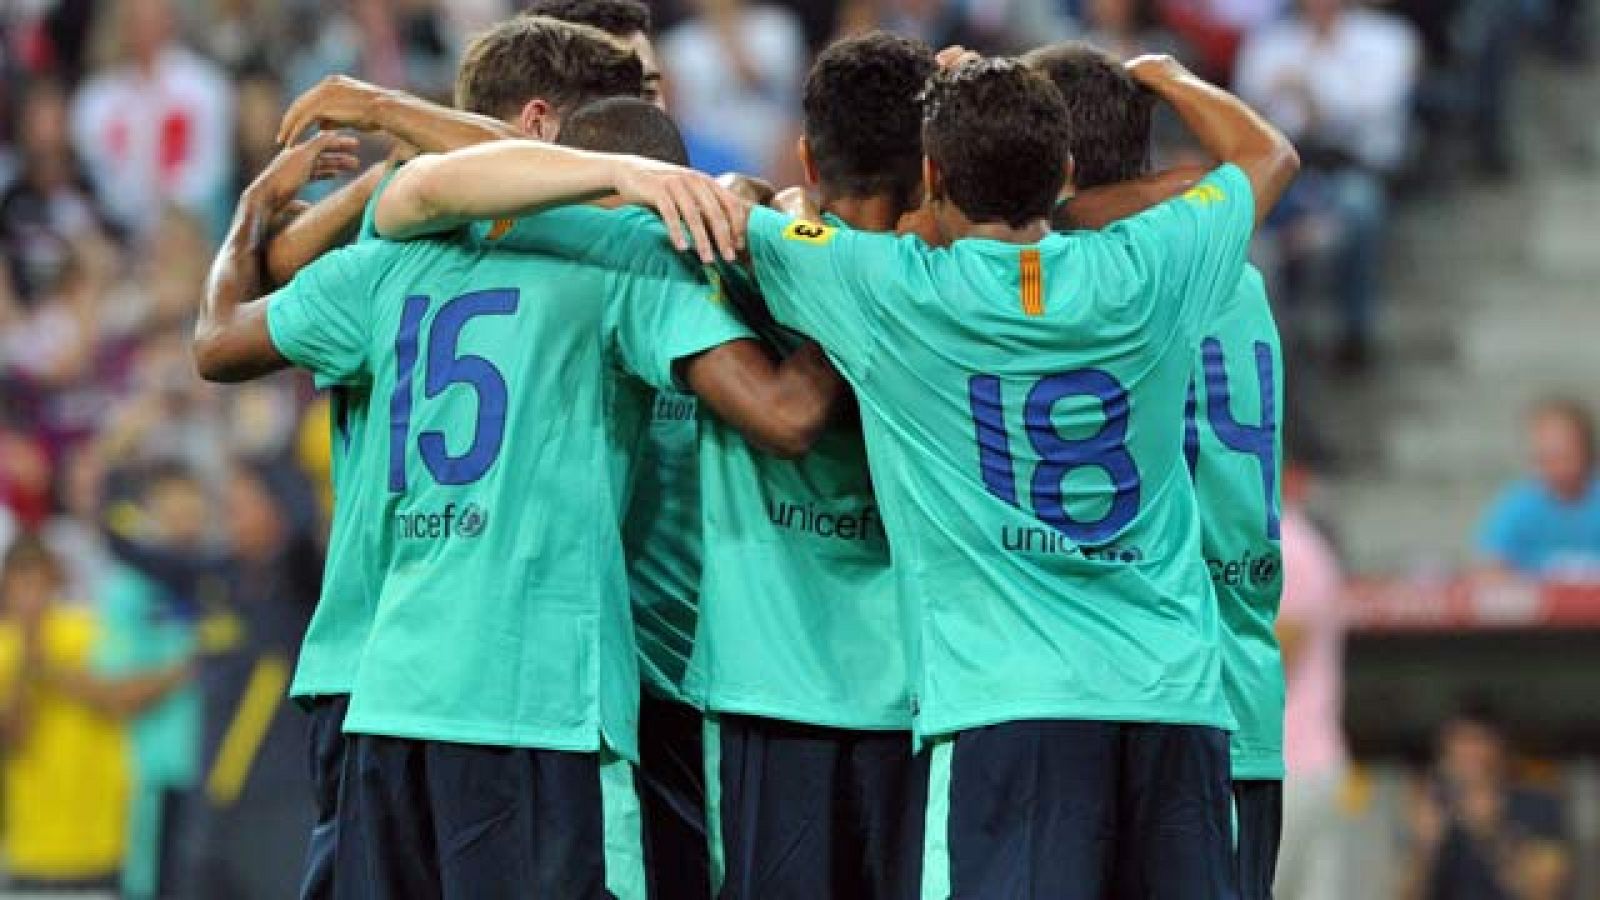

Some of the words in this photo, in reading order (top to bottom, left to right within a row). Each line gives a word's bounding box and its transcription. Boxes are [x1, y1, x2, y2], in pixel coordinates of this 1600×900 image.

[388, 287, 521, 493] 15
[968, 367, 1141, 546] 18
[396, 502, 456, 538] nicef
[768, 500, 876, 541] unicef
[1001, 525, 1085, 556] unic
[1206, 550, 1251, 586] cef
